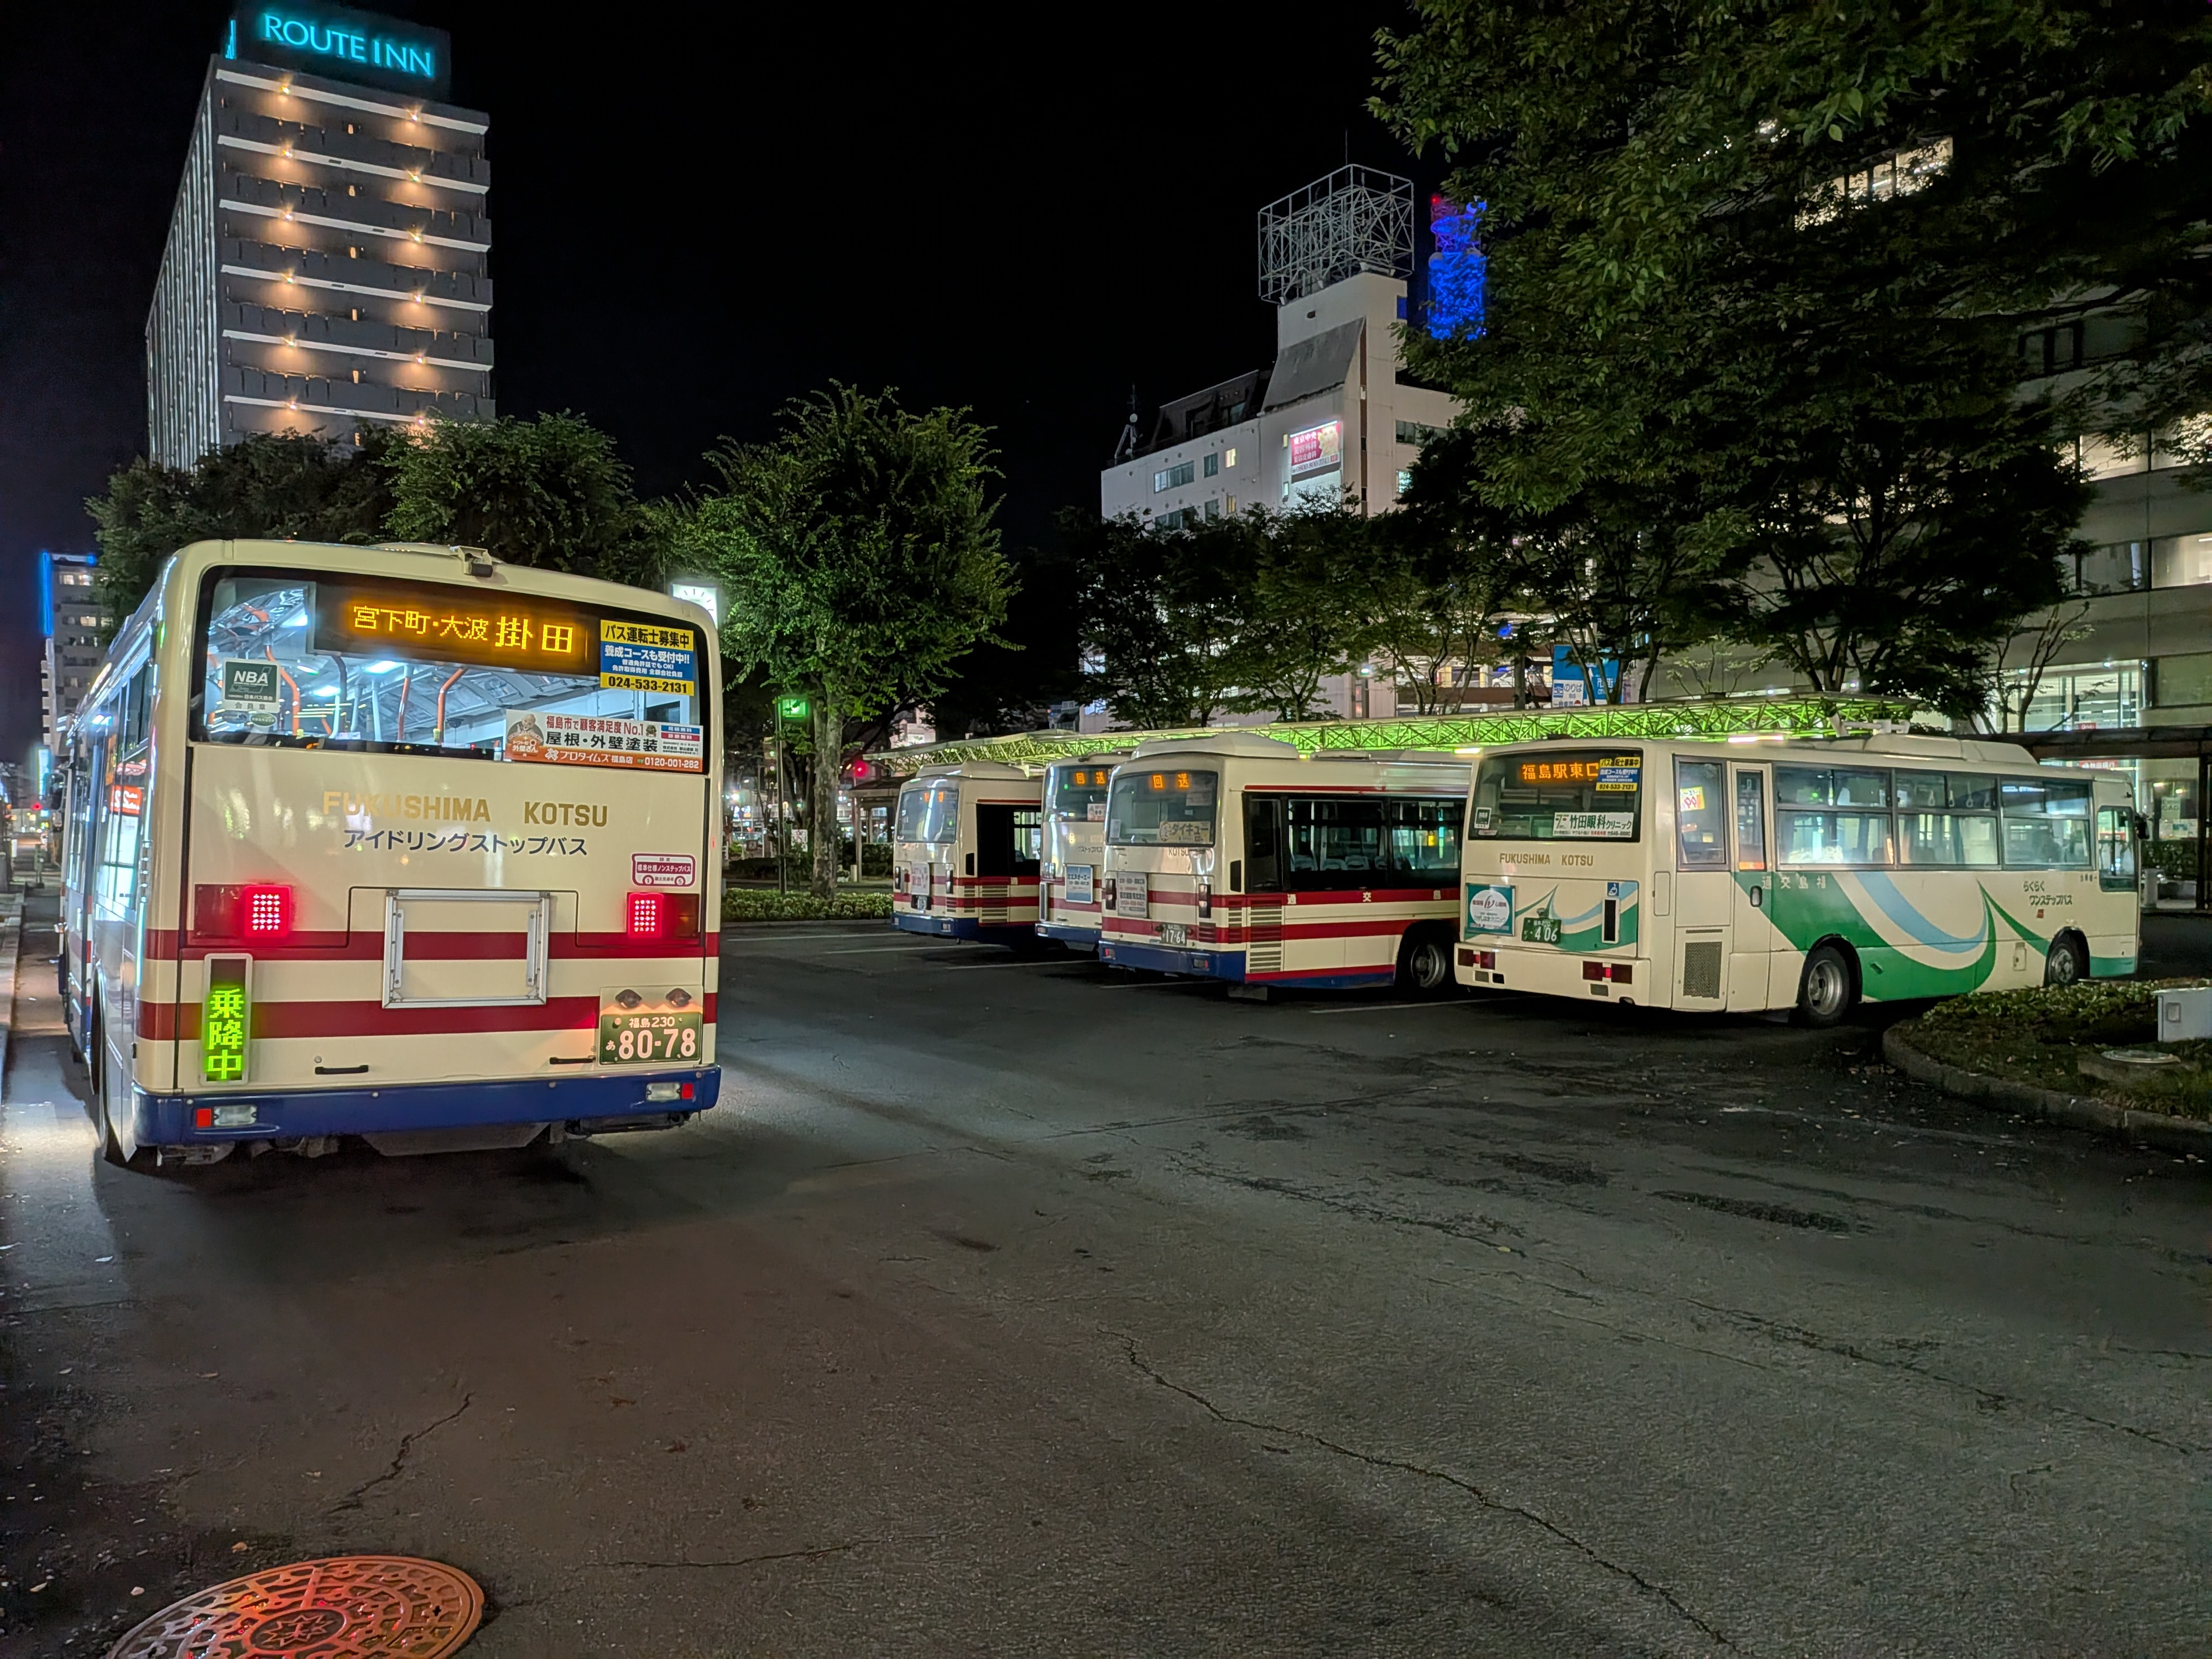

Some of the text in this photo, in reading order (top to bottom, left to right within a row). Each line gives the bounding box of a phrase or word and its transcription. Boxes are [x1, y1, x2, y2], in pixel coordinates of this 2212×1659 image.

[265, 14, 432, 76] ROUTE INN
[354, 605, 489, 641] 宮下町・大波
[605, 624, 690, 649] バス運転士募集中
[604, 644, 690, 665] 養成コースも受付中!!
[233, 670, 269, 684] NBA
[612, 665, 648, 675] 免許取得費用
[608, 676, 687, 693] 024-533-2131
[546, 731, 658, 752] 屋根・外壁塗装
[560, 750, 633, 764] プロタイムズ 福島店
[644, 757, 699, 769] 0120-001-282
[1076, 771, 1105, 784] 回送
[1522, 762, 1599, 780] 福島駅東口
[1152, 773, 1189, 788] 回送
[323, 791, 608, 827] FUKUSHIMA KOTSU
[344, 830, 588, 856] アイドリングストップバス
[1499, 852, 1594, 866] FUKUSHIMA KOTSU
[637, 864, 691, 872] 標準仕様ノンステップバス
[2023, 880, 2045, 892] らくらく
[2029, 894, 2073, 906] ワンステップバス
[208, 988, 244, 1079] 乗降中
[606, 1028, 696, 1060] あ 80-78
